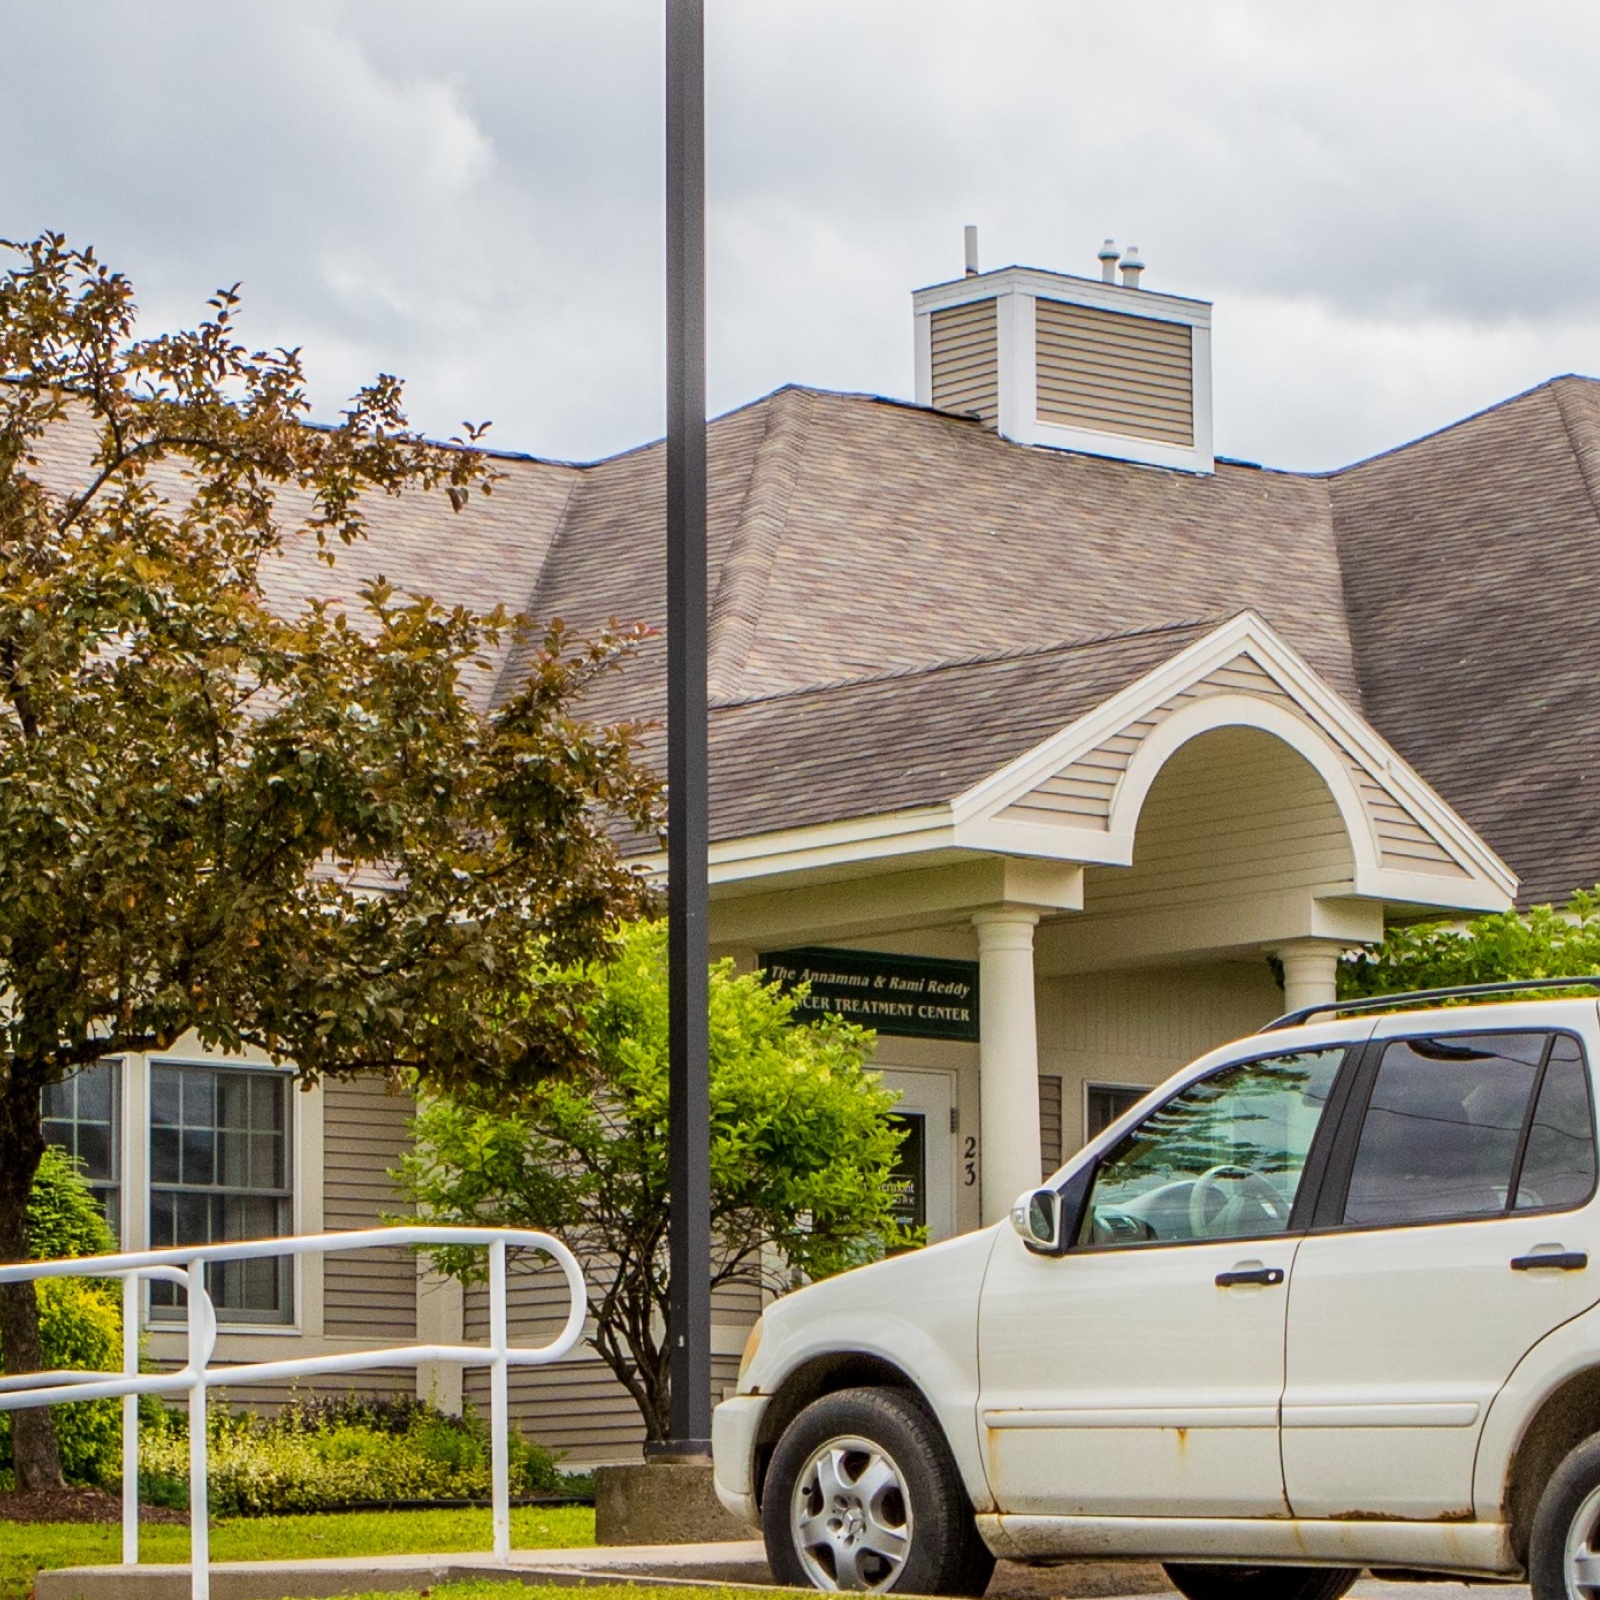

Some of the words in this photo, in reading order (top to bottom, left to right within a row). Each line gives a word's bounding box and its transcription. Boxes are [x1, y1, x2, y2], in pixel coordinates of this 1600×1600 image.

[771, 965, 796, 980] The
[800, 968, 869, 987] Annamma
[873, 976, 887, 989] &
[889, 976, 925, 991] Rami
[927, 980, 971, 999] Reddy
[834, 998, 914, 1017] TREATMENT
[918, 1005, 970, 1022] CENTER
[964, 1136, 977, 1187] 23
